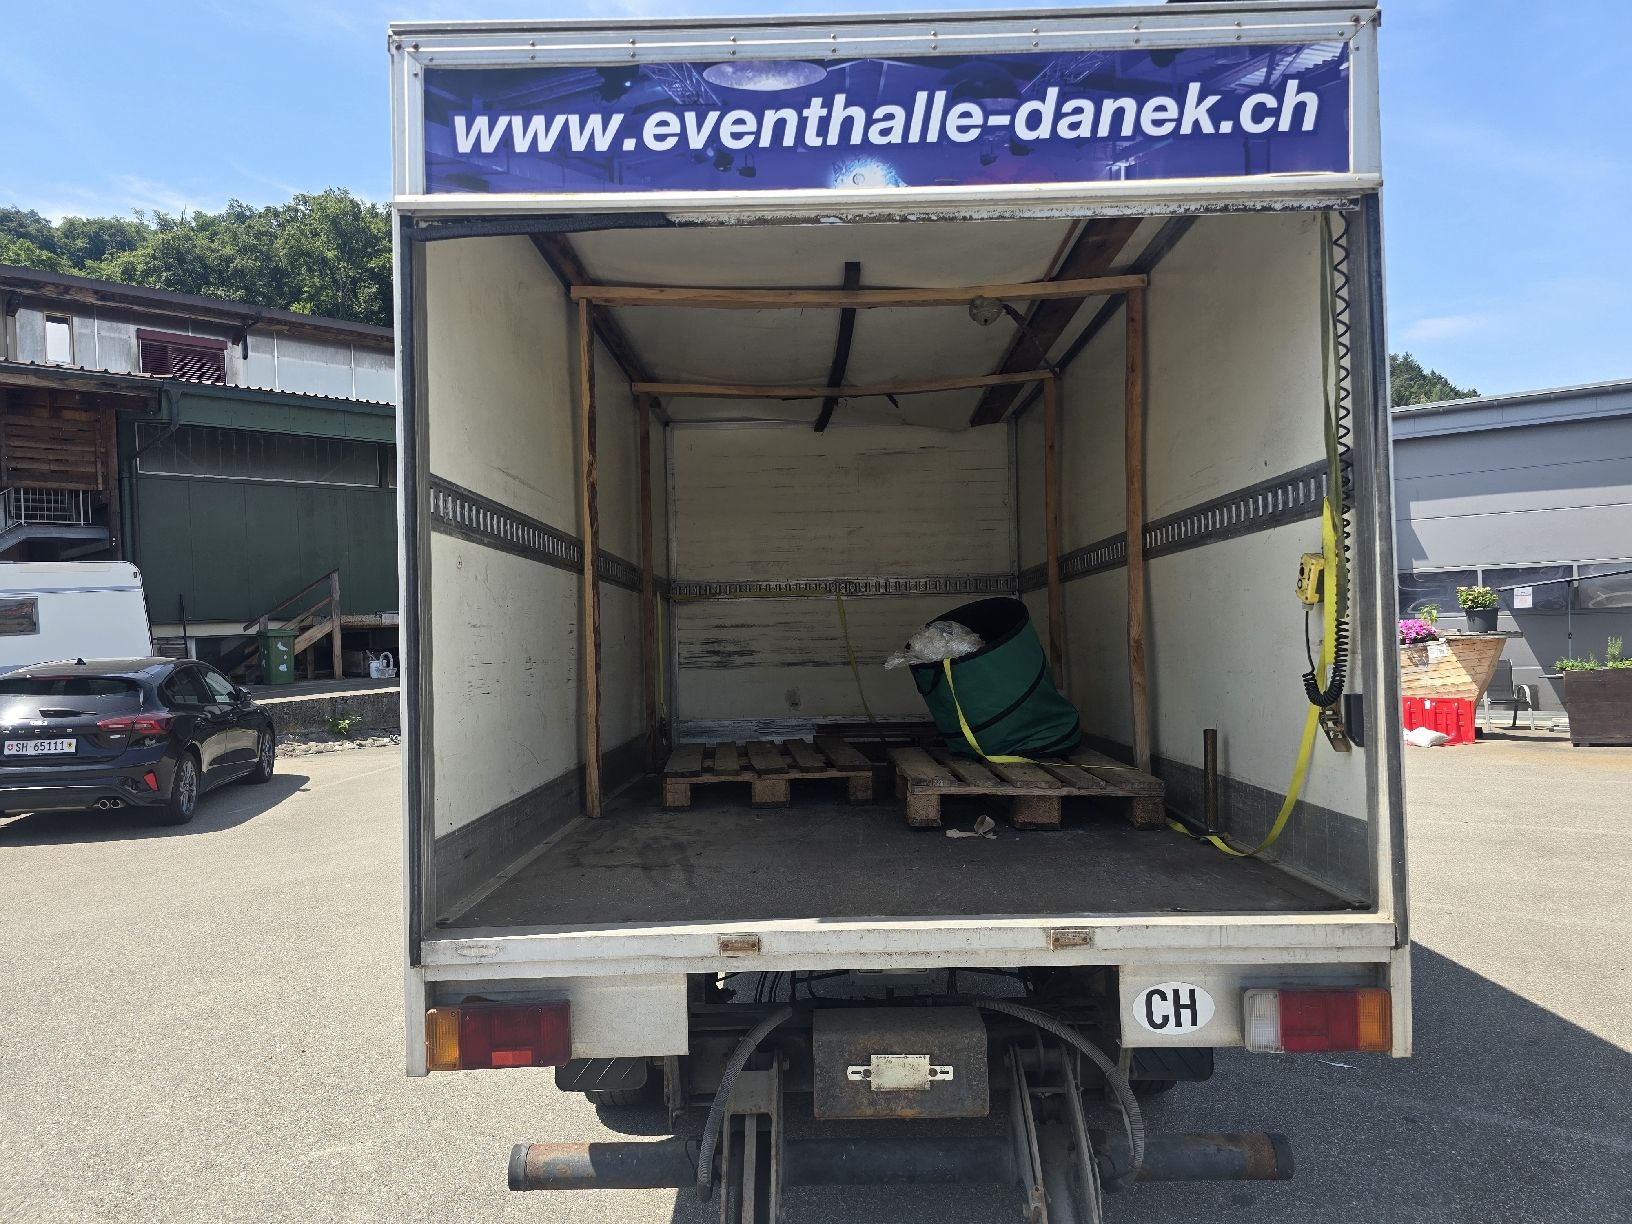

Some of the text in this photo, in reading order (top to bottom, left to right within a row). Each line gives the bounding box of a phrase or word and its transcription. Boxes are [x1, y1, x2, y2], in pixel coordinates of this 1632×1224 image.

[454, 79, 1319, 154] www.eventhalle-danek.ch
[15, 740, 65, 752] SH 65111
[1145, 988, 1198, 1030] CH
